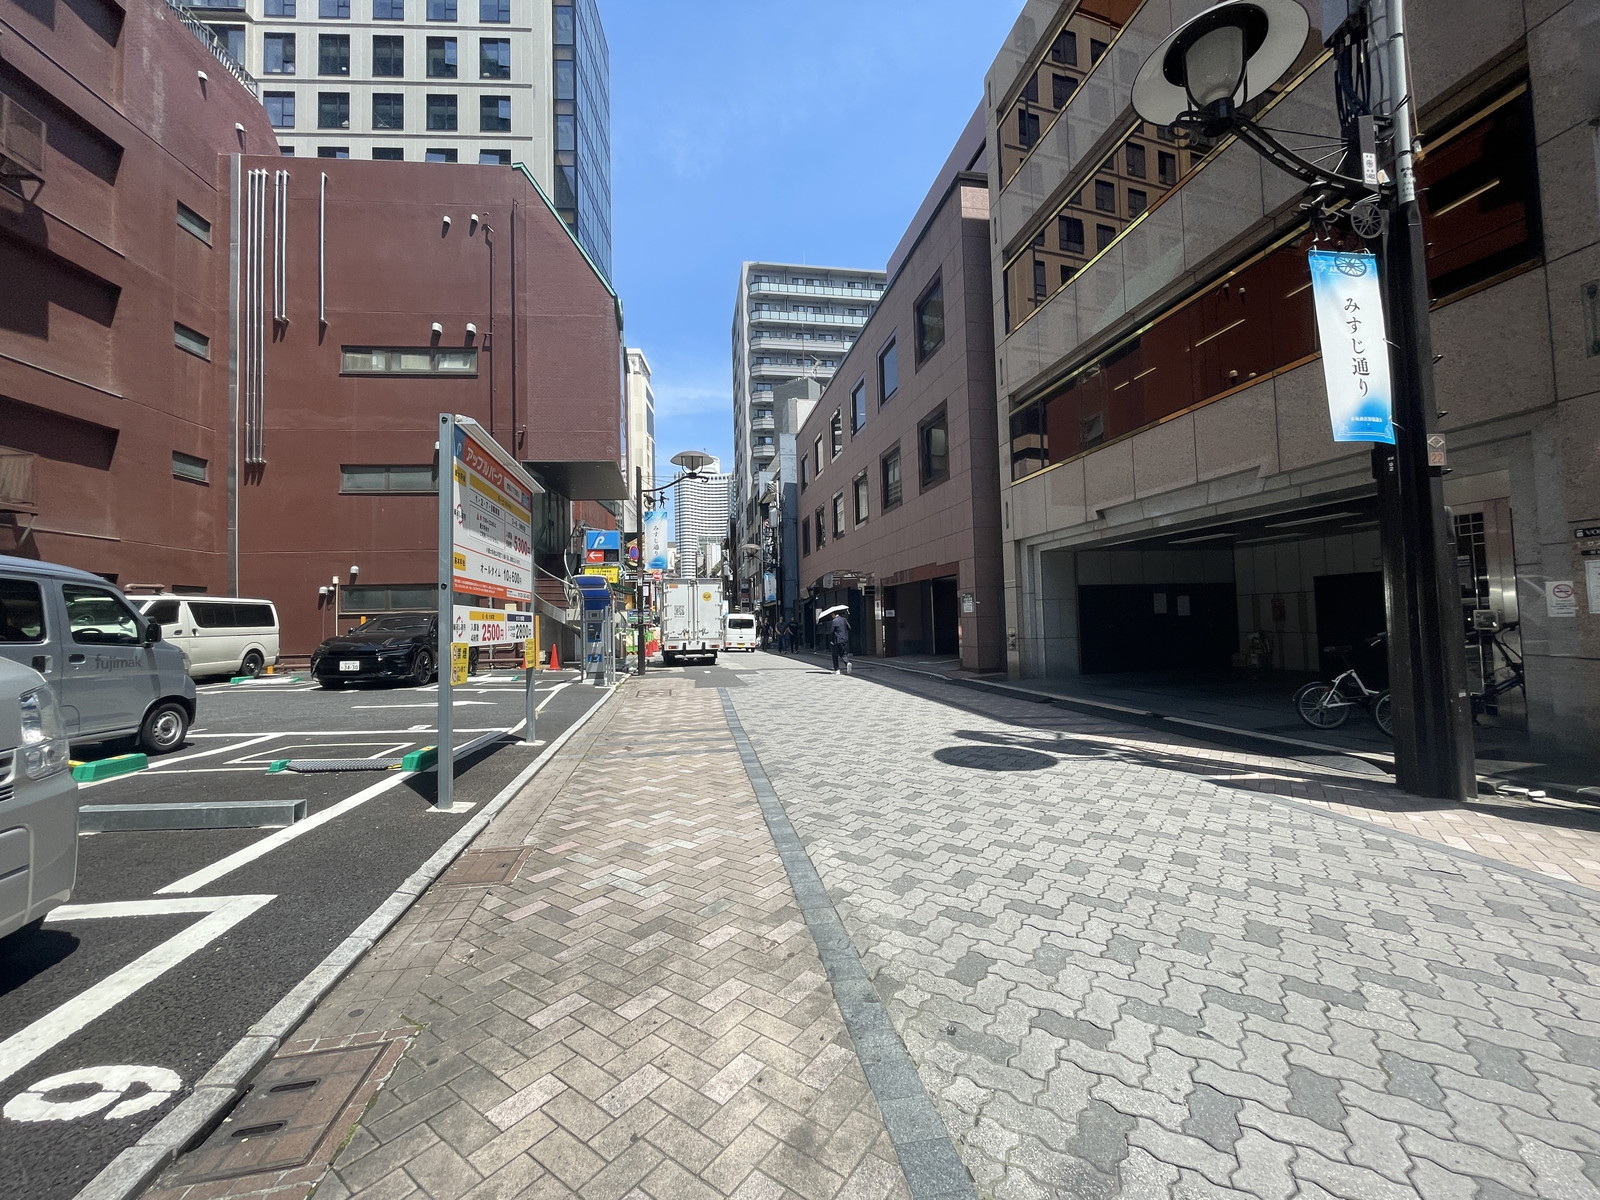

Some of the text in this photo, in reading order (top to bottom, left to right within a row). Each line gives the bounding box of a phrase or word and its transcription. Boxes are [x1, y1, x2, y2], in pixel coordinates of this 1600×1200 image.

[1343, 297, 1370, 398] みすじ通り
[466, 446, 503, 486] アップルパーク
[1431, 453, 1443, 464] 22
[480, 563, 501, 578] オールタイム
[481, 623, 505, 642] 2500円
[95, 653, 142, 672] fujimak
